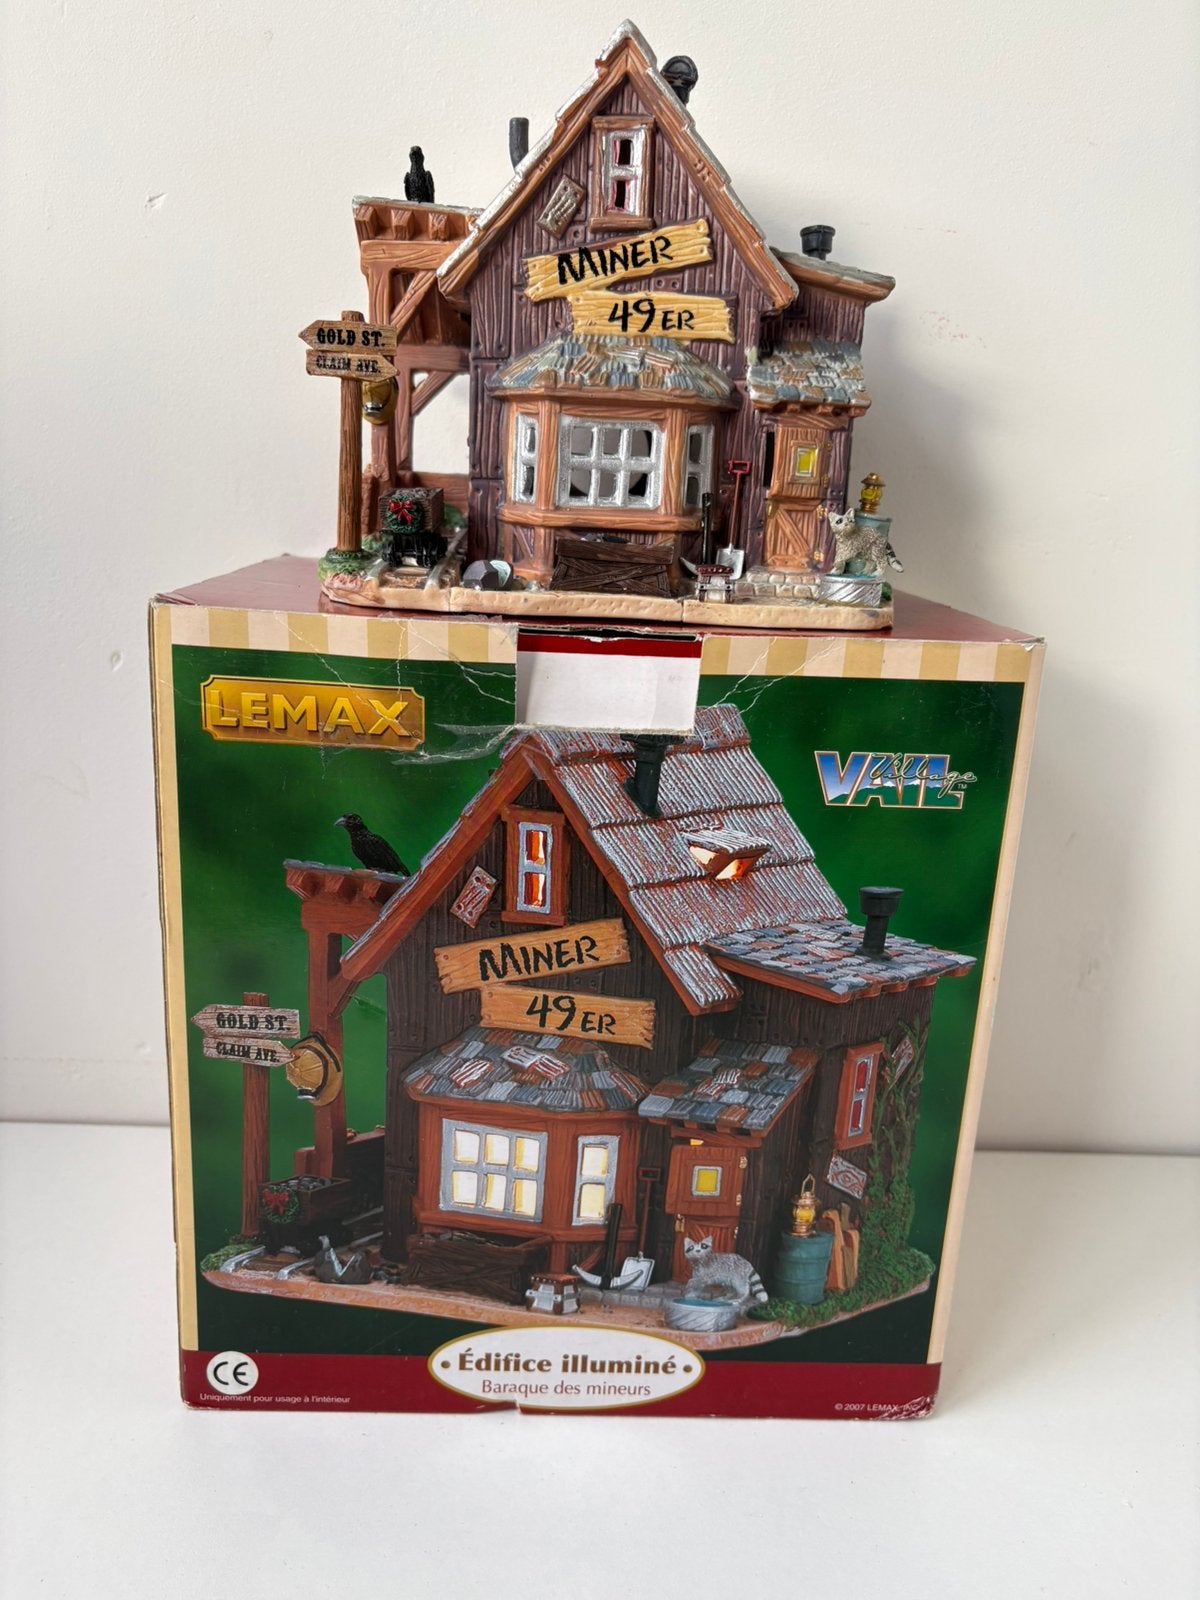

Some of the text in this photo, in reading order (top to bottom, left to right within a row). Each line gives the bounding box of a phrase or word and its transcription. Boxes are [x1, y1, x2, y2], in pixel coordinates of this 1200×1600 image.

[557, 235, 674, 285] MINER
[316, 327, 386, 347] GOLD ST.
[315, 355, 382, 374] CLAIM AVE.
[205, 689, 411, 737] LEMAX
[814, 750, 965, 809] VAIL
[869, 752, 977, 798] Village
[478, 935, 600, 982] MINER
[216, 1012, 291, 1031] GOLD ST.
[216, 1042, 280, 1062] CLAIM AVE.
[213, 1361, 249, 1386] CE
[458, 1348, 677, 1374] Édifice illuminé
[199, 1393, 251, 1402] Uniquement
[275, 1396, 301, 1404] usage
[304, 1394, 310, 1403] à
[312, 1395, 351, 1403] l'intérieur
[481, 1379, 651, 1397] Baraque des mineurs
